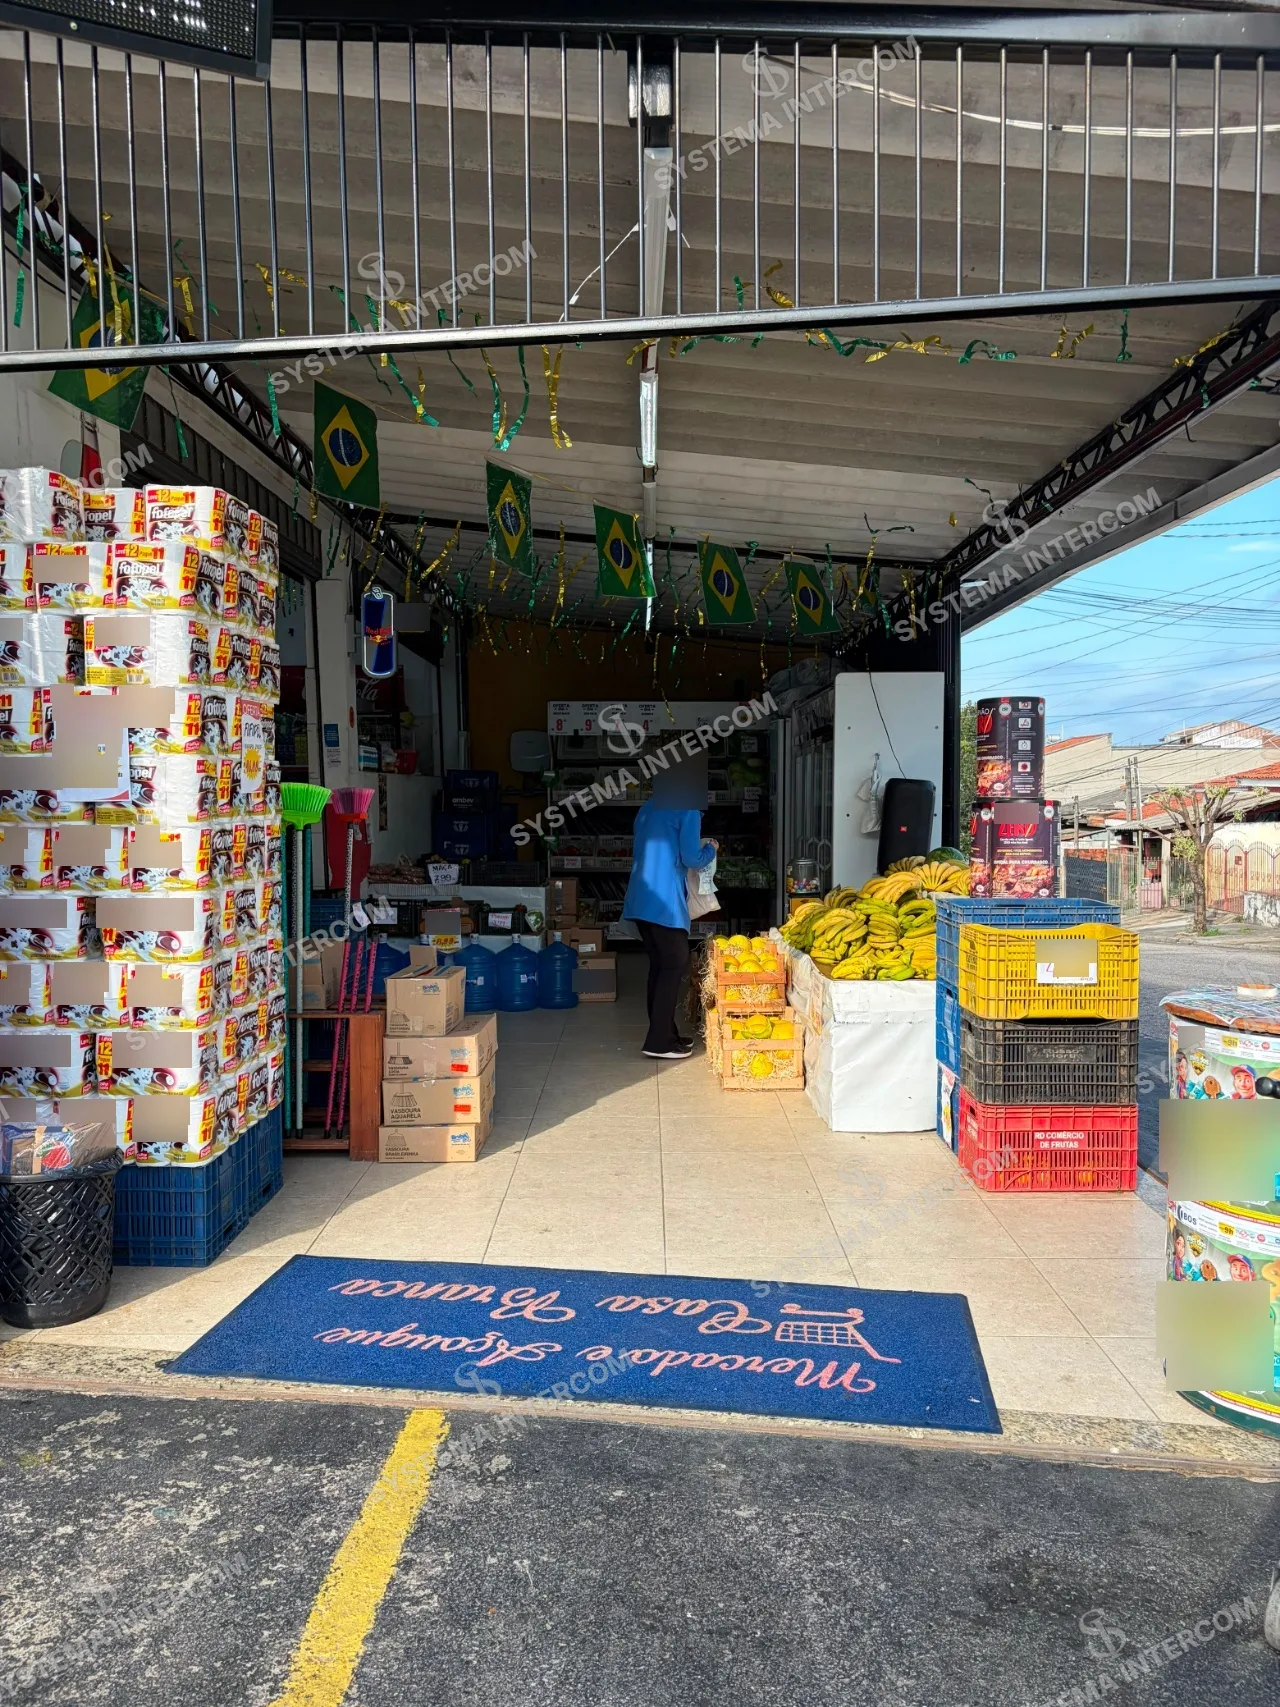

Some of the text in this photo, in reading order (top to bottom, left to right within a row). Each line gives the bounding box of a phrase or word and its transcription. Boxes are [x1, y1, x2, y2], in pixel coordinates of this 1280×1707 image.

[157, 490, 170, 503] 12
[183, 492, 195, 503] 11
[125, 544, 138, 556] 12
[152, 548, 164, 559] 11
[186, 554, 198, 567] 12
[182, 577, 195, 590] 11
[366, 626, 379, 635] Red
[189, 701, 200, 714] 12
[185, 724, 199, 736] 11
[557, 719, 563, 731] 8
[585, 719, 592, 731] 9
[222, 766, 231, 779] 12
[201, 837, 210, 850] 12
[235, 831, 245, 844] 12
[236, 957, 247, 970] 12
[99, 1042, 112, 1055] 12
[203, 1107, 214, 1120] 12
[1034, 1132, 1045, 1140] RD
[1052, 1141, 1079, 1149] FRUTAS
[328, 1278, 772, 1335] Casa Branca
[312, 1322, 563, 1368] Açougue
[618, 1347, 877, 1394] Mercado
